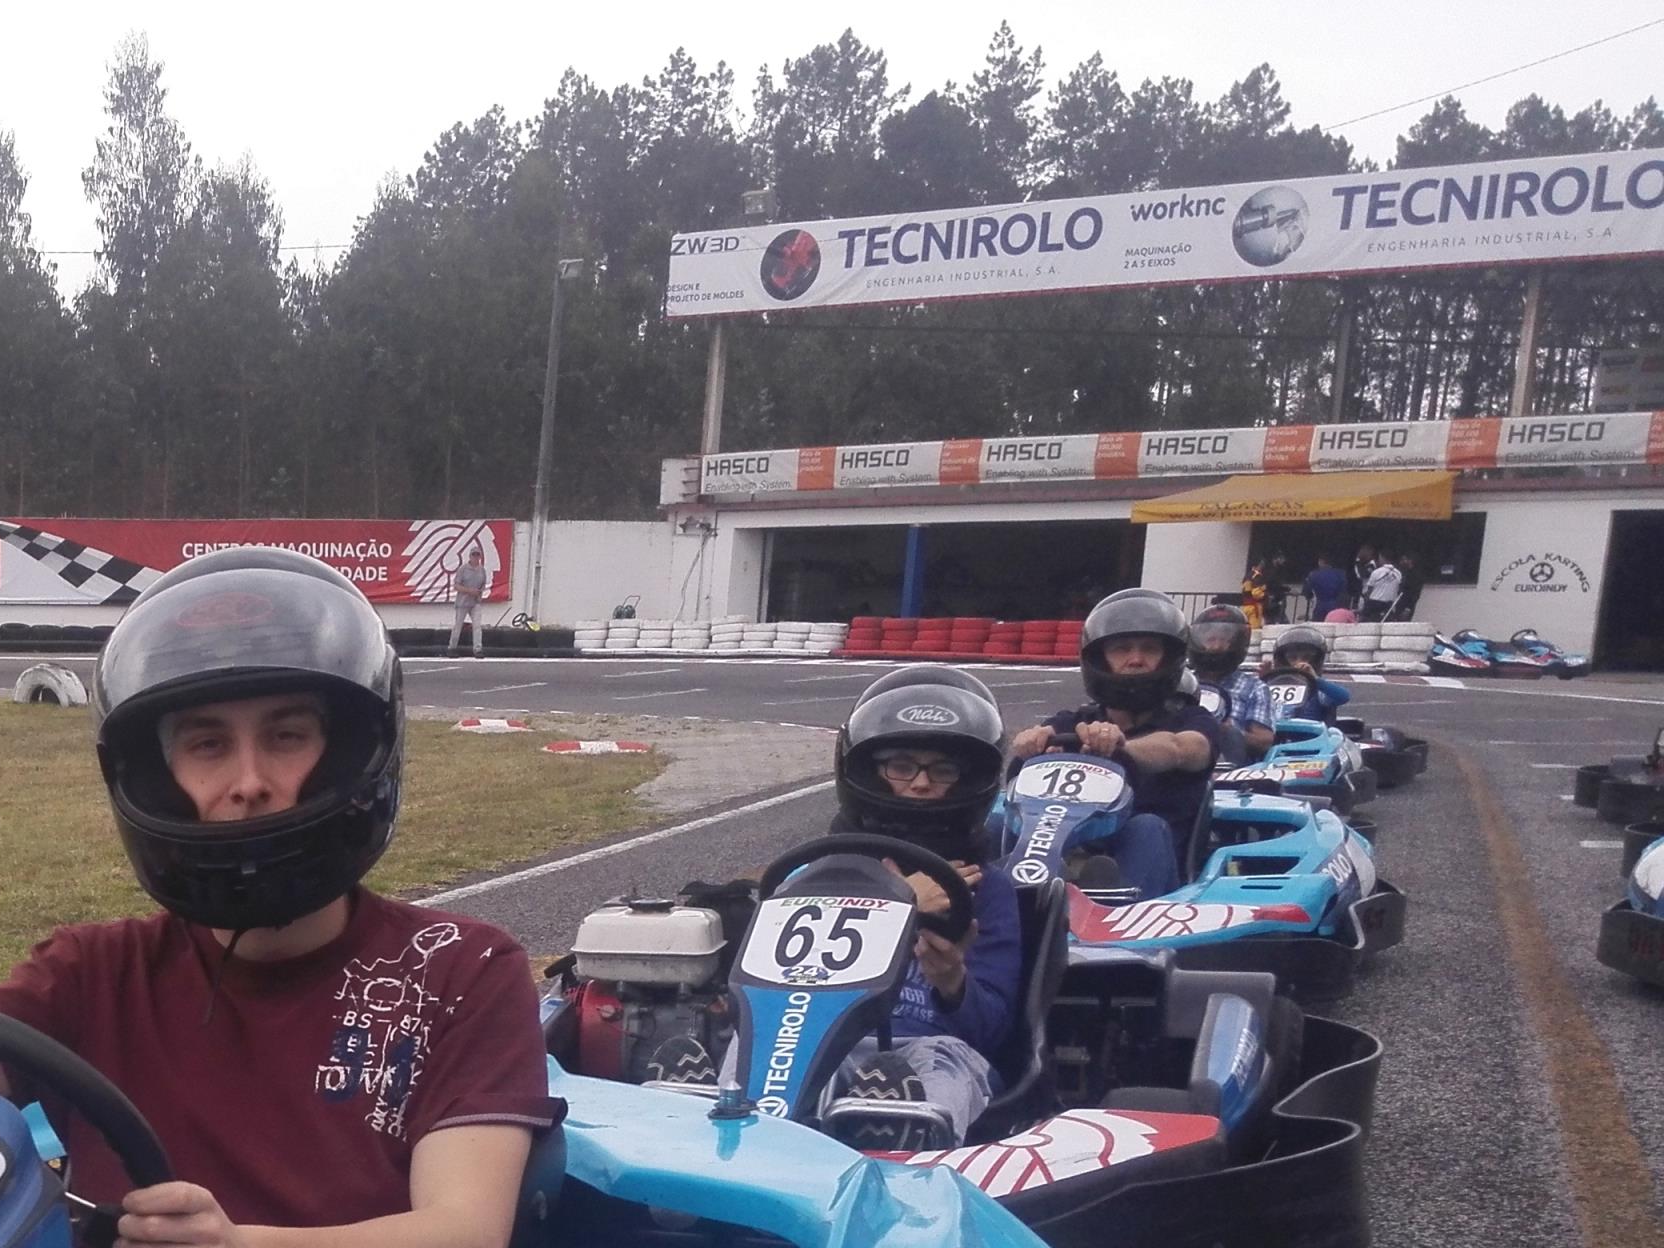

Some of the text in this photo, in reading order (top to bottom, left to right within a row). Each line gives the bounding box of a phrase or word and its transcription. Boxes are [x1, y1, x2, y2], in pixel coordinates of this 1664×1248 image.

[1332, 159, 1664, 231] TECNIROLO
[838, 206, 1104, 268] TECNIROLO
[1367, 237, 1467, 253] ENGENHARIA
[1124, 242, 1192, 257] MAQUINAÇÃO
[1123, 260, 1129, 269] 2
[1131, 260, 1138, 268] A
[1147, 257, 1176, 267] EIXOS
[866, 273, 945, 289] ENGENHARIA
[702, 292, 711, 301] DE
[713, 290, 745, 300] MOLDES
[1319, 428, 1408, 450] HASCO
[1507, 421, 1605, 444] HASCO
[986, 442, 1063, 462] HASCO
[1145, 435, 1229, 457] HASCO
[841, 449, 911, 469] HASCO
[1559, 451, 1586, 461] with
[706, 457, 770, 476] HASCO
[1028, 468, 1049, 477] with
[1191, 463, 1213, 471] with
[1491, 552, 1591, 593] ESCOLA KARTING
[1514, 583, 1568, 592] EUROINDY
[1040, 768, 1087, 797] 18
[780, 897, 891, 909] EUROINDY
[774, 904, 870, 972] 65
[788, 966, 820, 977] 24
[763, 991, 812, 1096] TECNIROLO
